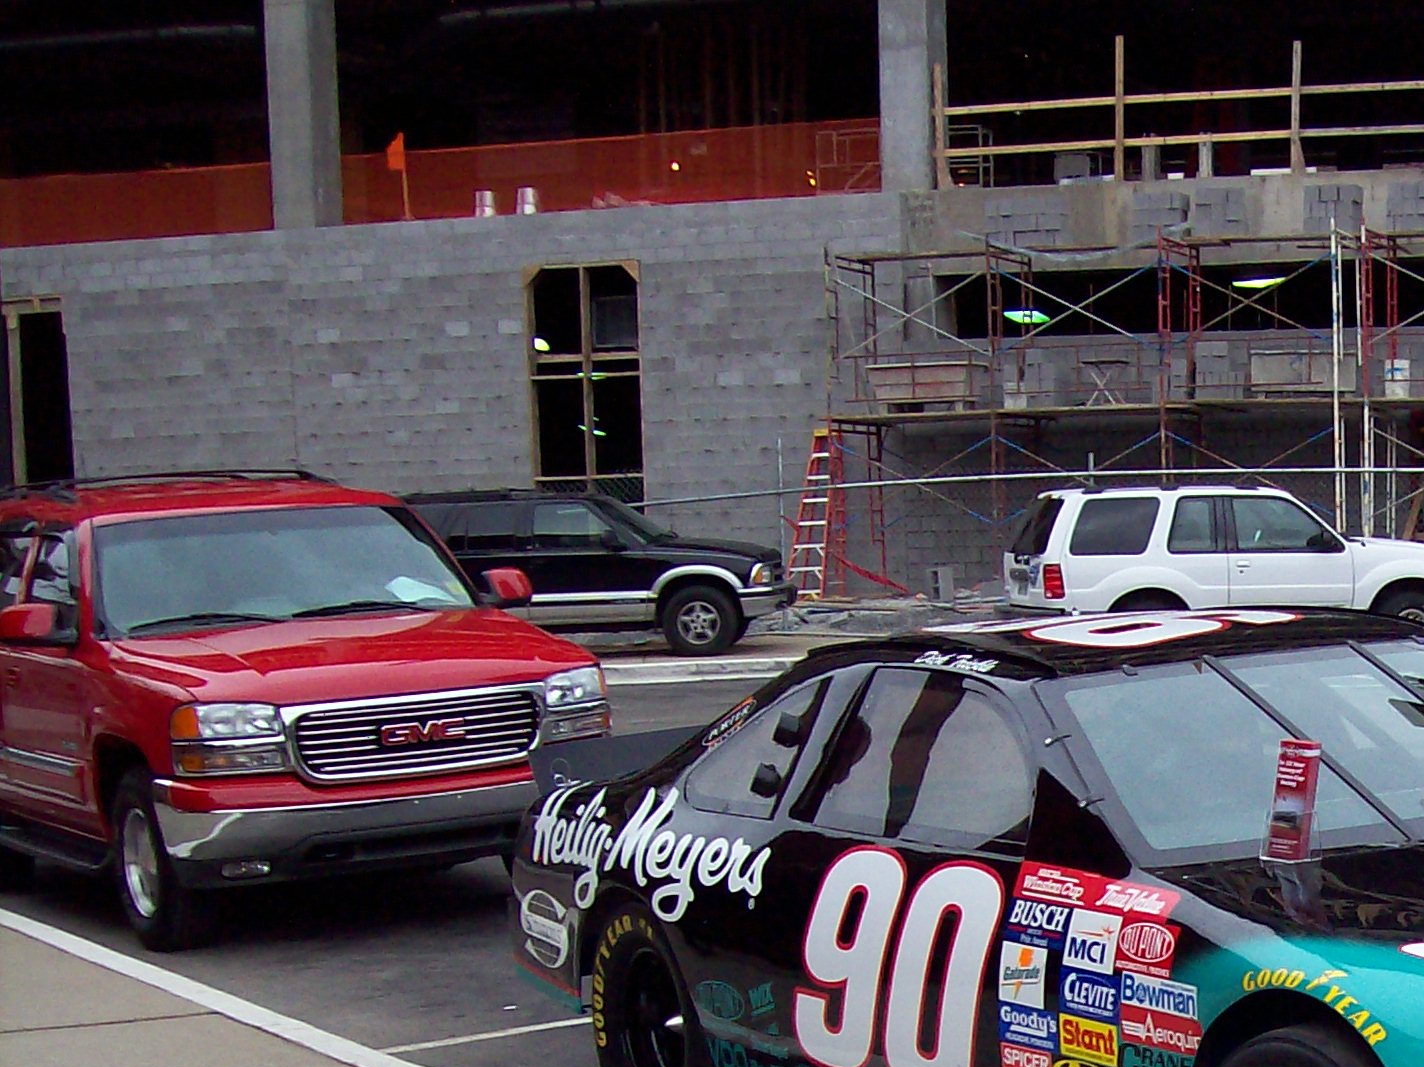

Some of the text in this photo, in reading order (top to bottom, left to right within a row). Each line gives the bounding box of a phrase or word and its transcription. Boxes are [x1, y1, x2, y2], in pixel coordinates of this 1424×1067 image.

[381, 718, 465, 746] GMC
[1060, 882, 1085, 902] Cup
[1009, 900, 1070, 932] BUSCH
[1068, 936, 1106, 965] MCI
[1064, 972, 1116, 1010] CLEVITE
[1123, 974, 1196, 1018] Bowman
[1001, 1006, 1057, 1037] Goody's
[1062, 1019, 1116, 1056] Stant
